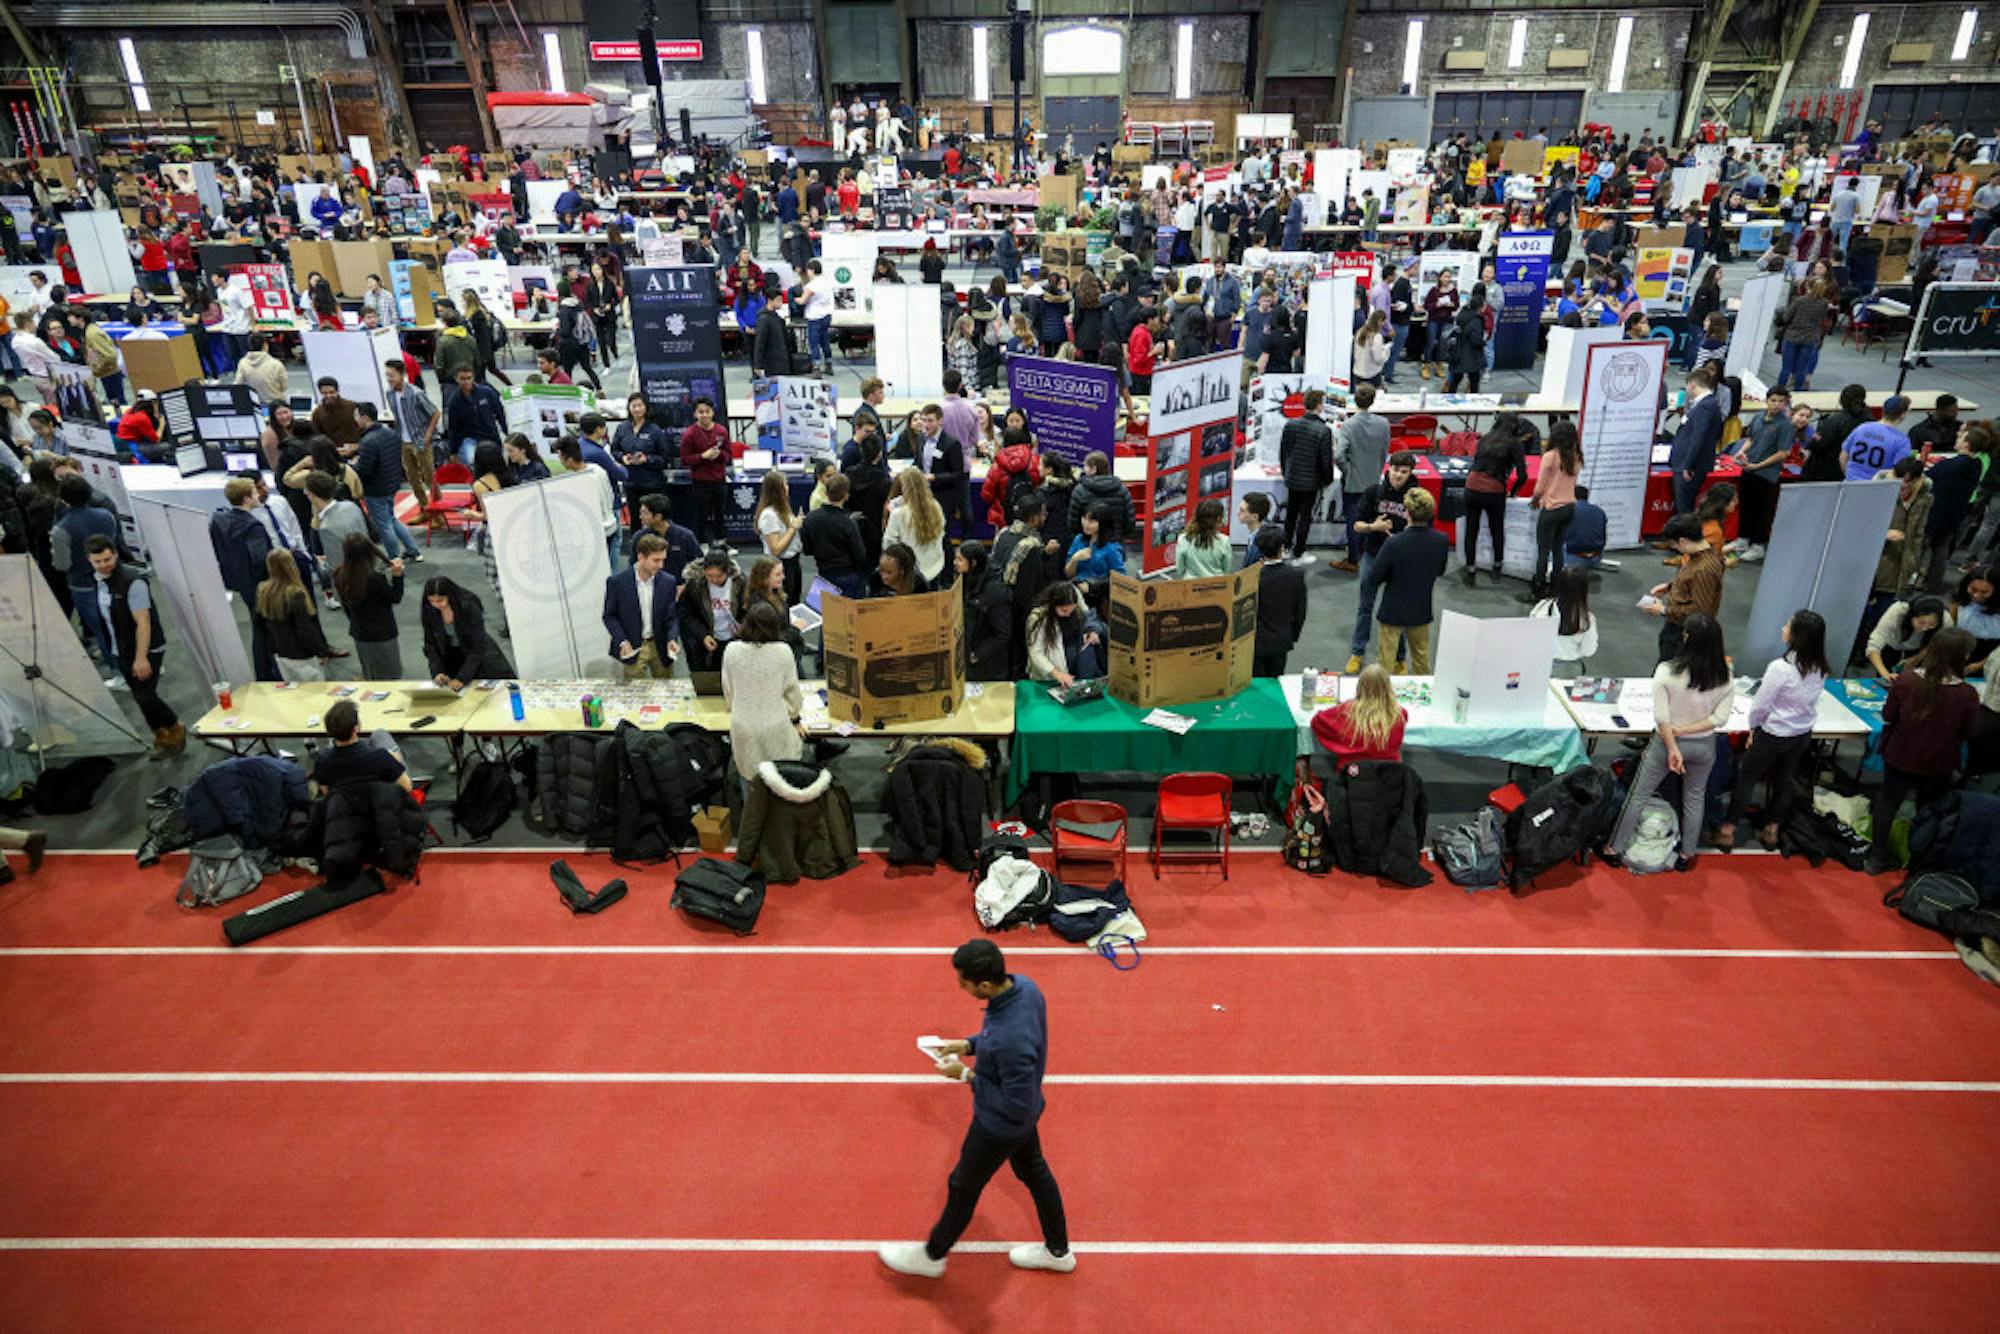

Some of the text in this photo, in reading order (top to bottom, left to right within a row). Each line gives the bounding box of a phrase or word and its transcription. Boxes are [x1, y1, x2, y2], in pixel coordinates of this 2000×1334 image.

[1933, 315, 1978, 335] cru
[1019, 373, 1103, 398] DELTA SIGMA PI
[1852, 441, 1885, 468] 20
